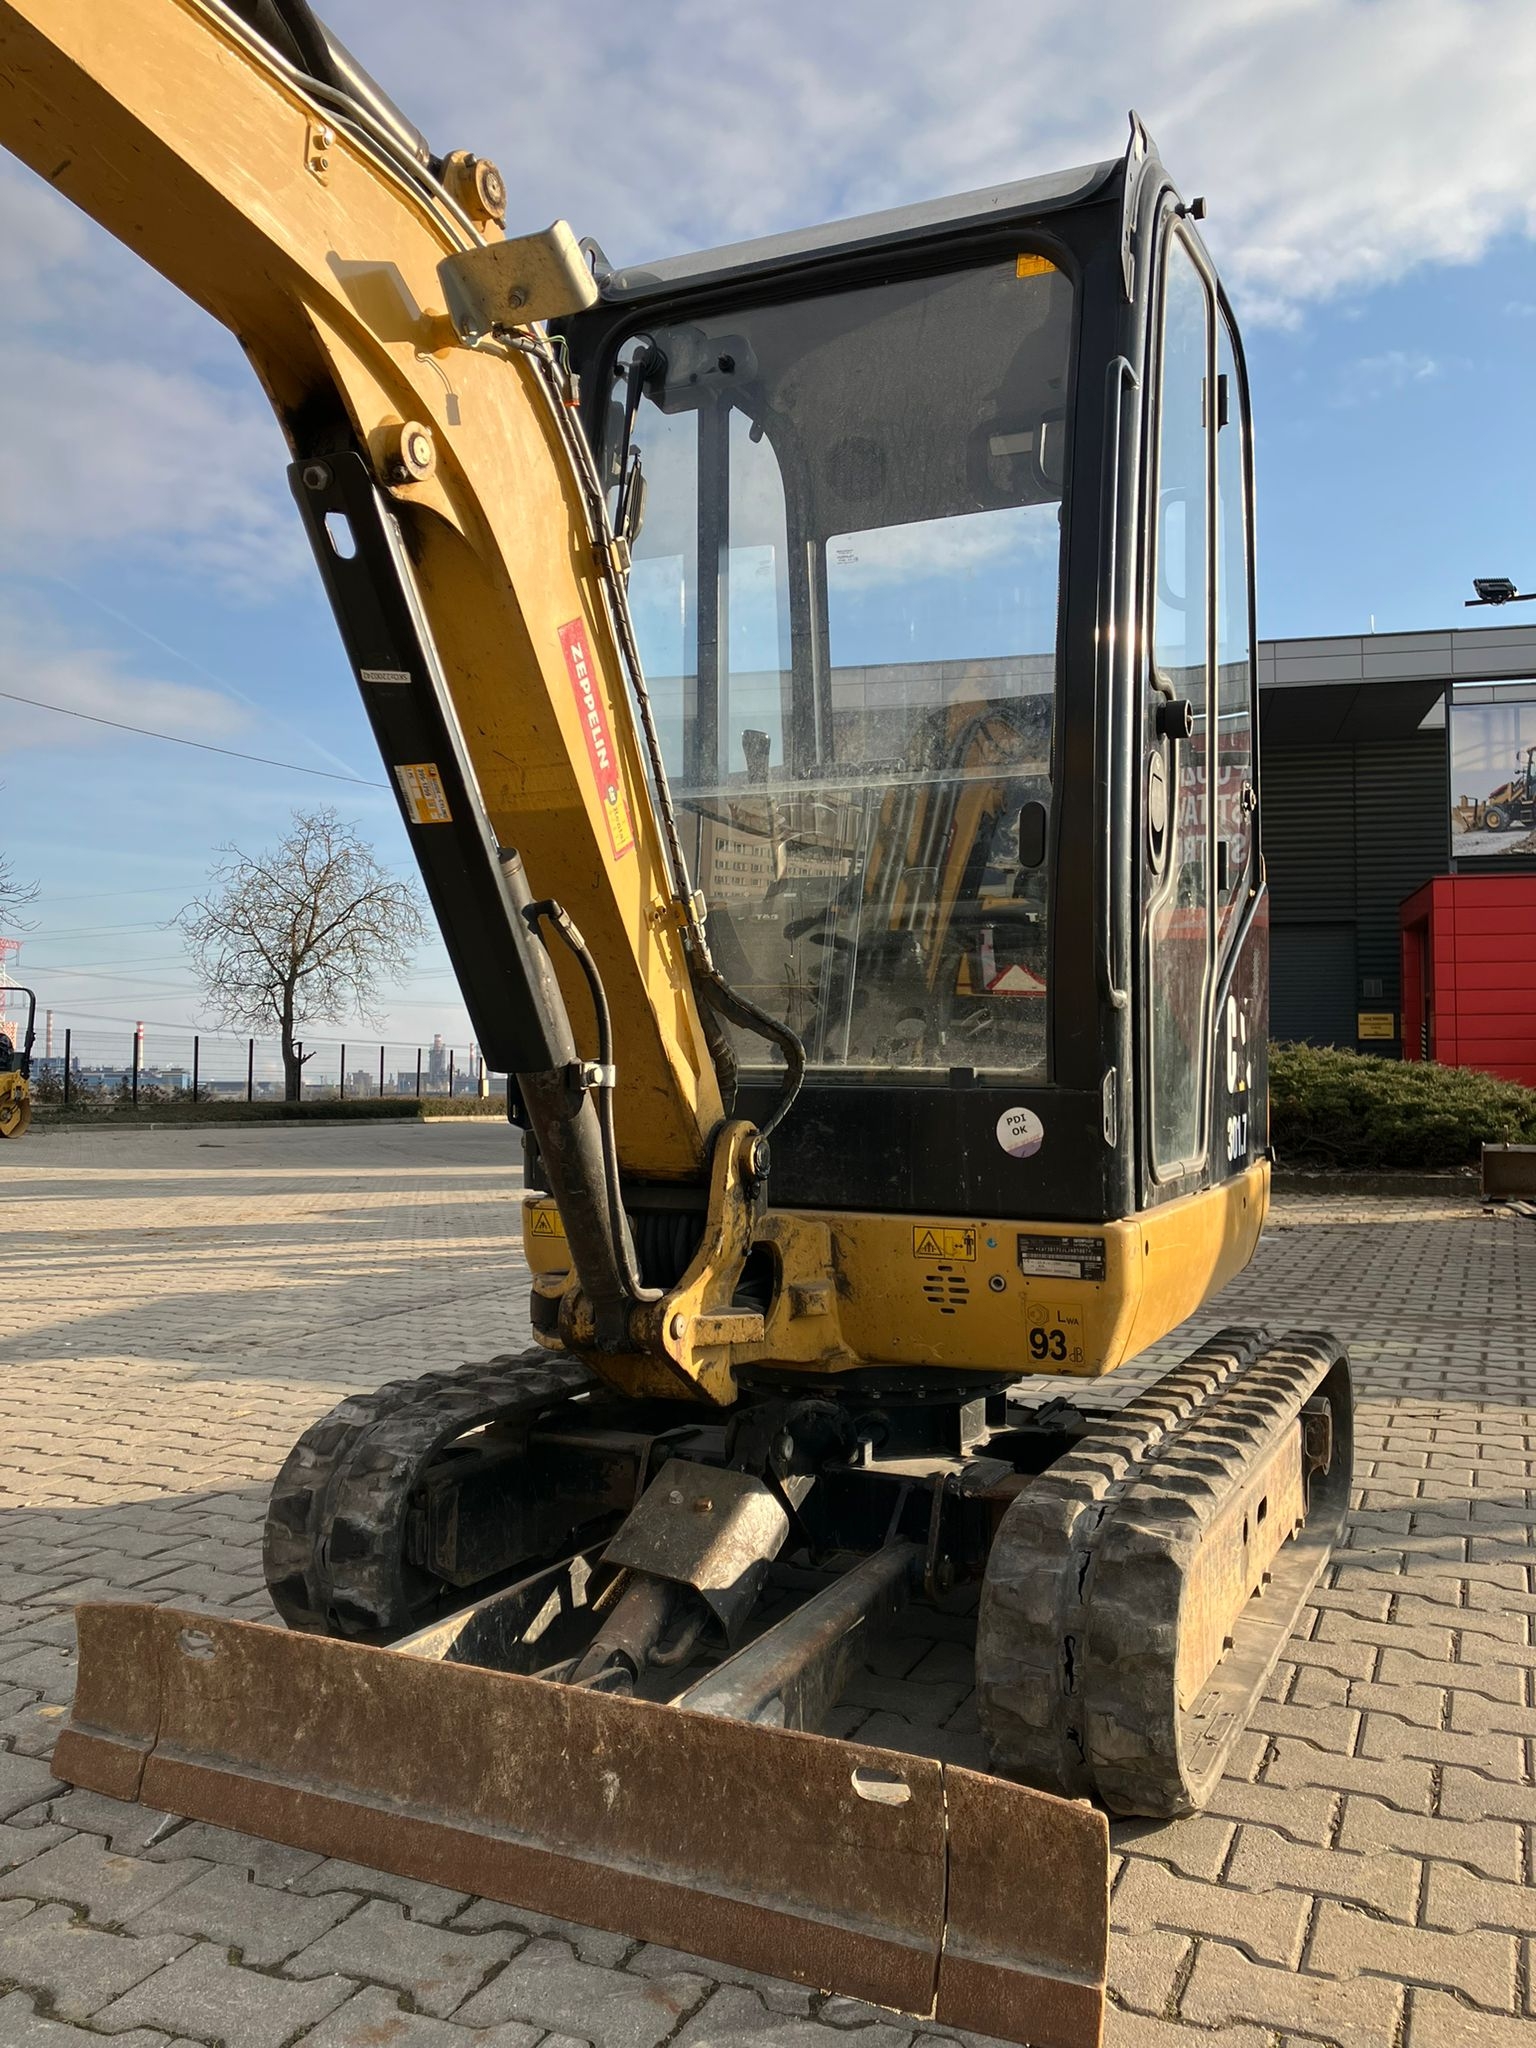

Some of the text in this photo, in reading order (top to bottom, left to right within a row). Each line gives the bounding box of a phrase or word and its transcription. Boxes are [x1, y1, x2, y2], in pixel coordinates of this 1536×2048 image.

[570, 642, 610, 771] ZEPPELIN
[1006, 1113, 1027, 1126] PDI
[1012, 1125, 1028, 1136] OK
[1227, 1113, 1247, 1162] 301.7
[1029, 1327, 1084, 1363] 93 dB
